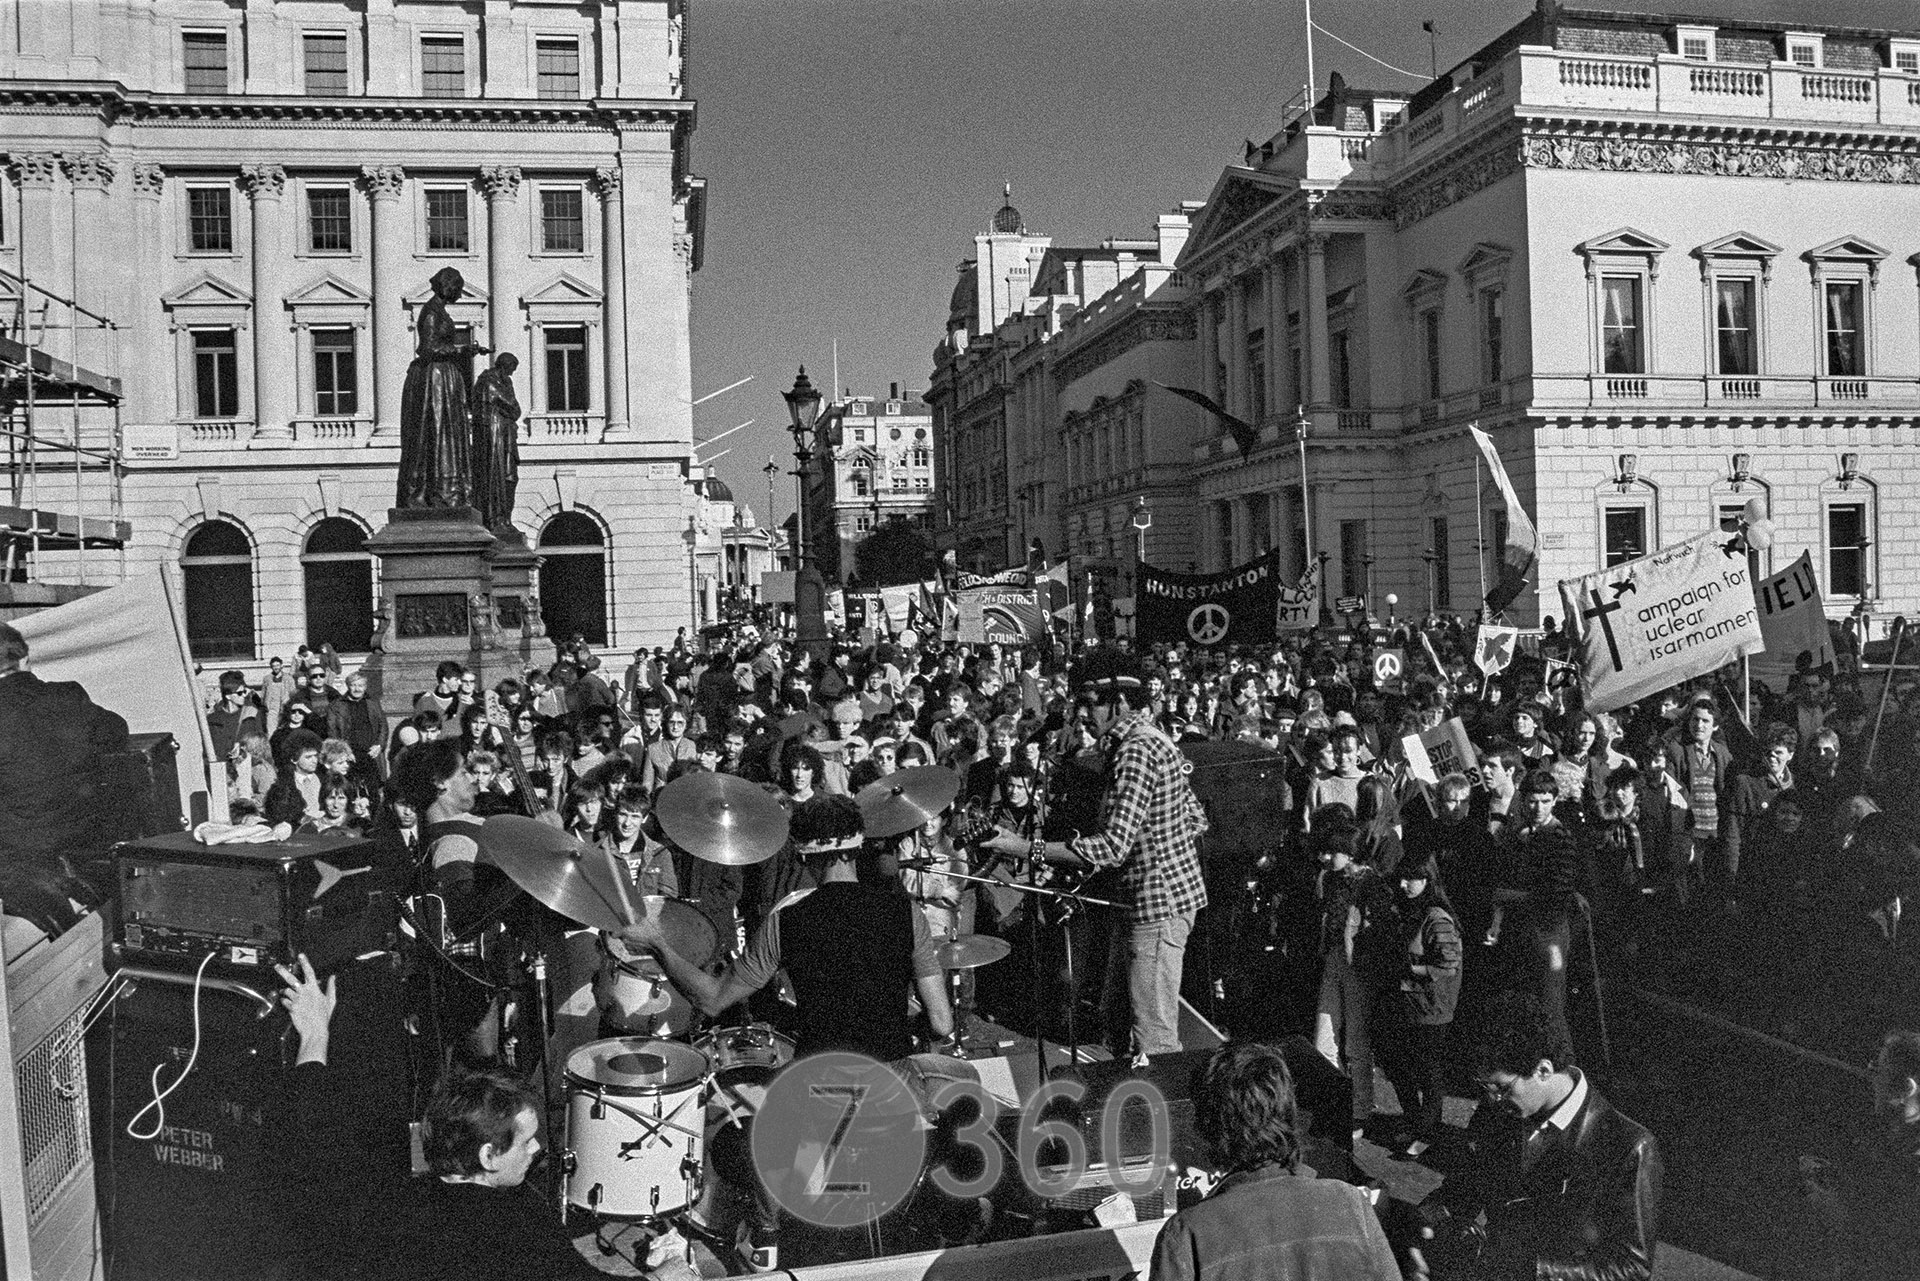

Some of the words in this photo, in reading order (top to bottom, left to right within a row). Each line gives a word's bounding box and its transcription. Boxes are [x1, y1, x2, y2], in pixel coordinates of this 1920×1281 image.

[1653, 545, 1695, 567] Norwich
[1146, 564, 1269, 599] HUNSTANTON
[1722, 569, 1746, 588] for
[1754, 562, 1815, 615] IELD
[997, 593, 1038, 605] DISTRICT
[160, 1125, 213, 1150] PETER
[153, 1143, 225, 1172] WEBBER
